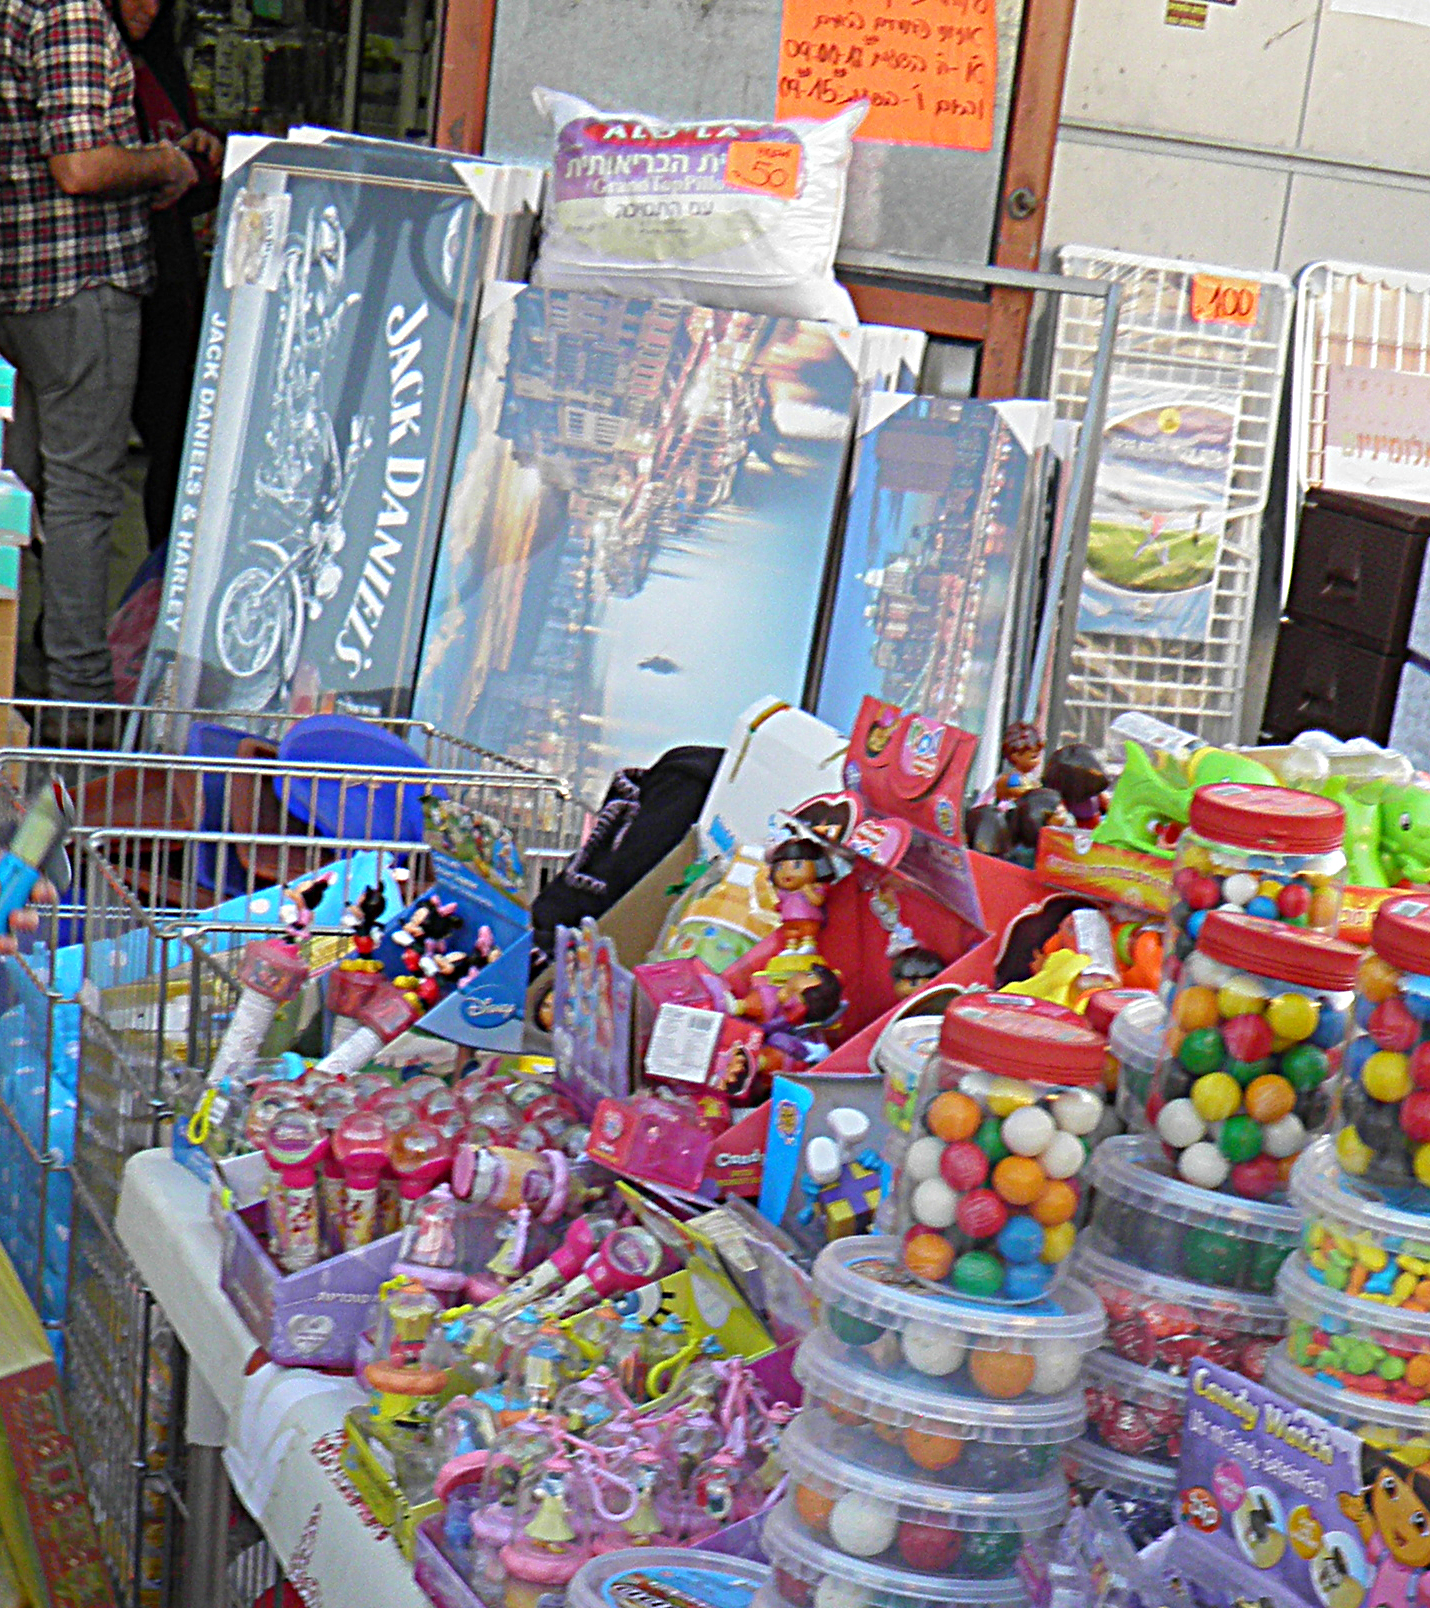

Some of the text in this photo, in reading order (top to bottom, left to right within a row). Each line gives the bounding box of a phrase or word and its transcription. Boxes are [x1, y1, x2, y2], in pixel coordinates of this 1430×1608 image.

[163, 312, 226, 634] JACK DANIELS & HARLEY
[386, 302, 429, 446] JACK
